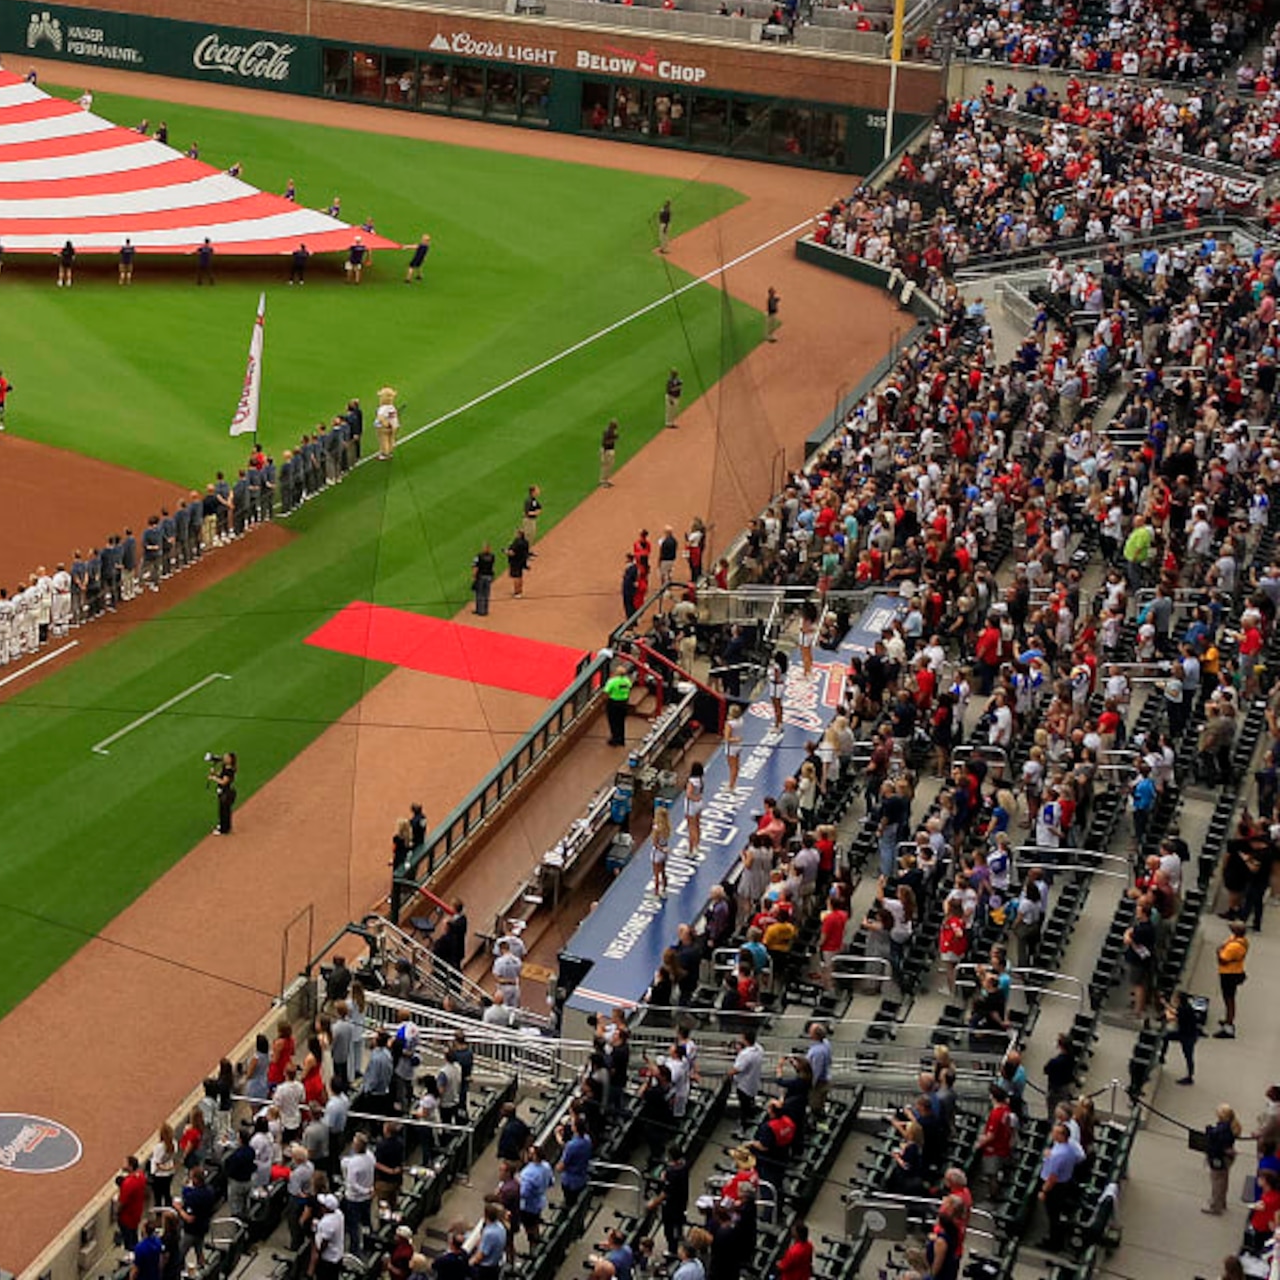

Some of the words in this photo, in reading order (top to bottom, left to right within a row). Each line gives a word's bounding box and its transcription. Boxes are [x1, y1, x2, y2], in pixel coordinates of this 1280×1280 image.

[67, 26, 104, 42] KAISER
[451, 31, 504, 59] Coors
[506, 45, 558, 65] LIGHT
[193, 33, 297, 82] Coca-Cola
[602, 911, 654, 959] WELCOME
